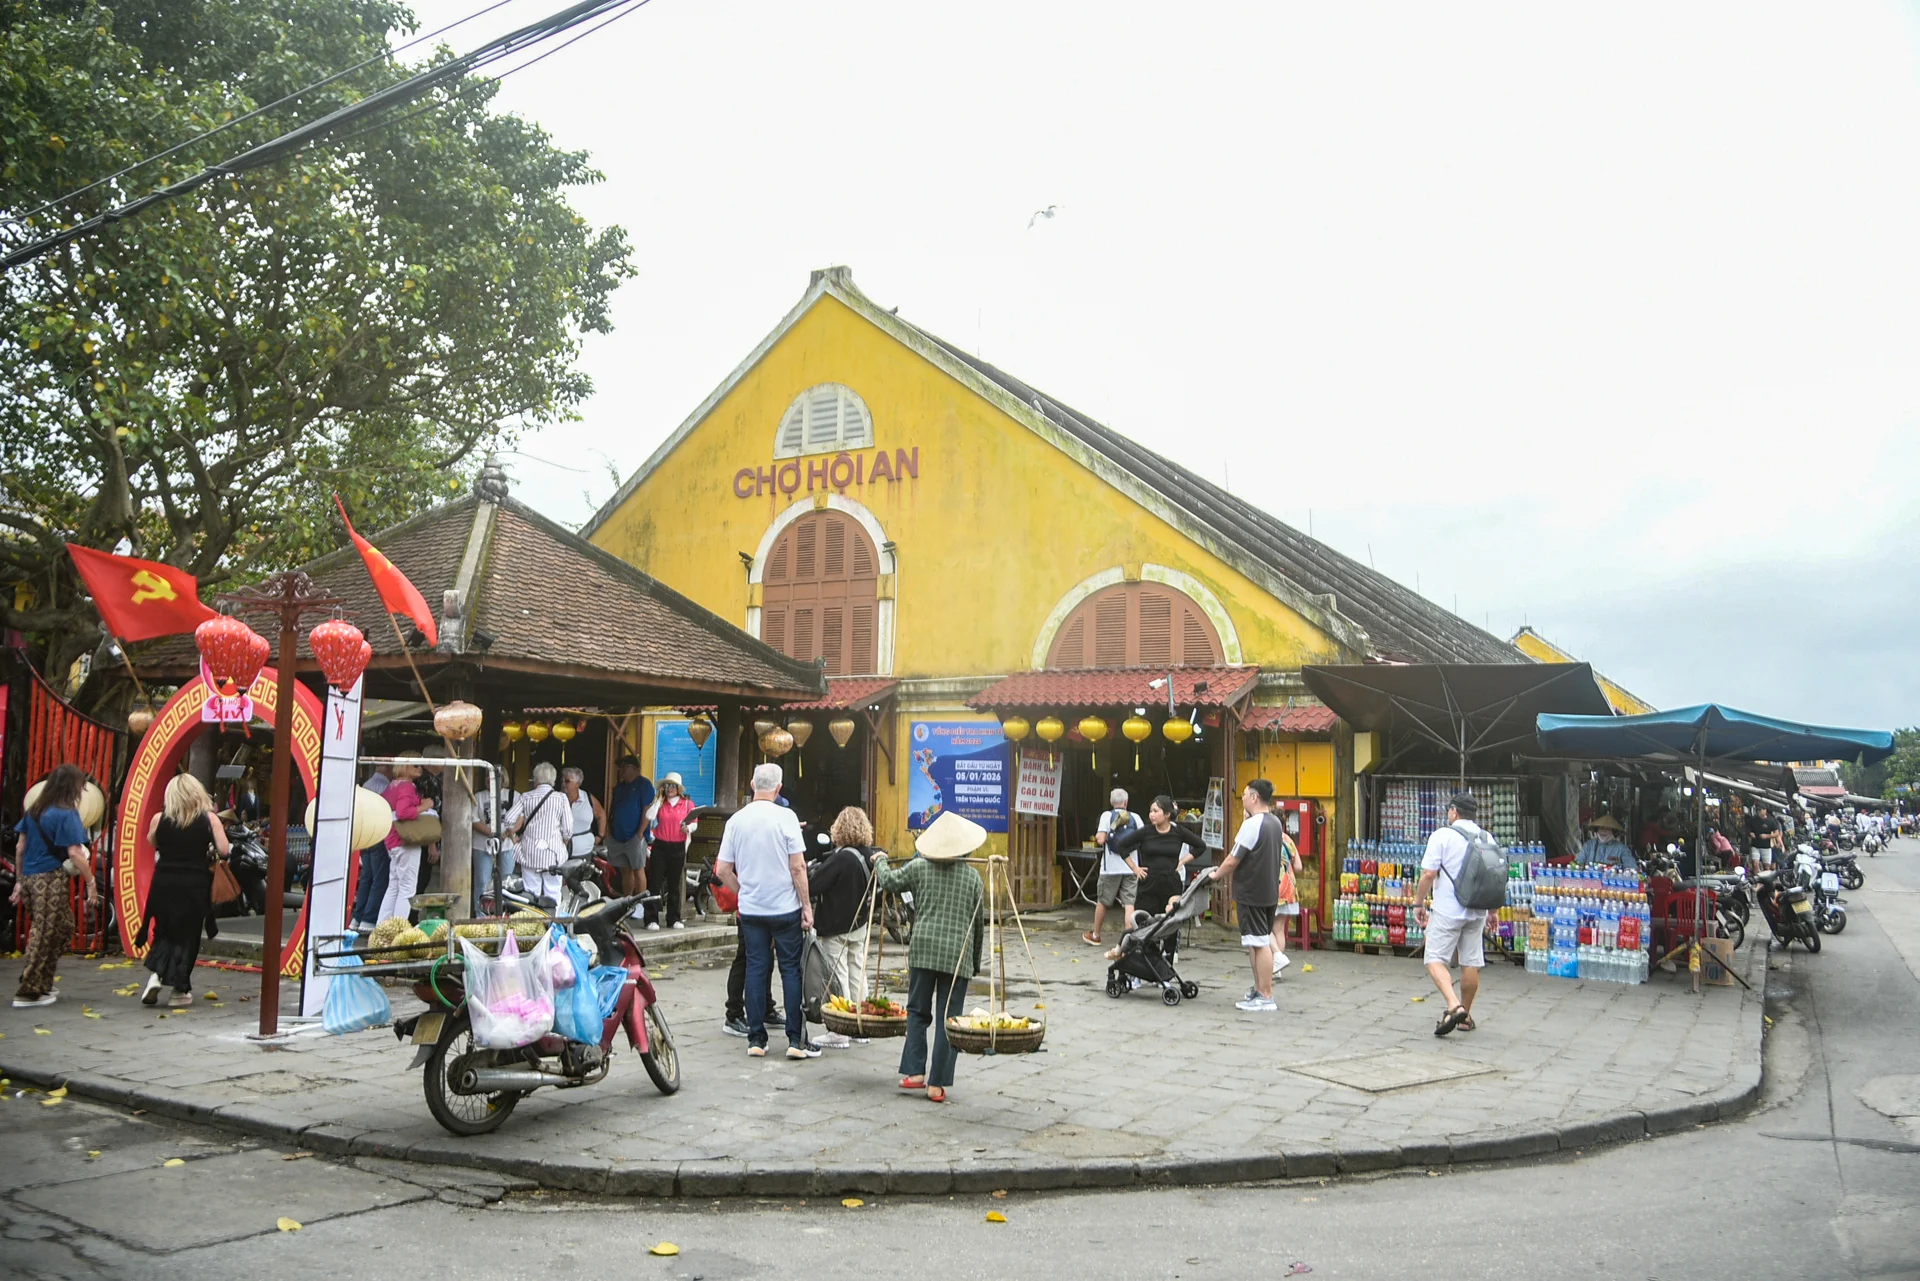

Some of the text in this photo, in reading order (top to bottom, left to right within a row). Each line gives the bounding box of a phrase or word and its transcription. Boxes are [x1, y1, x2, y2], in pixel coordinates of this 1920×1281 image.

[733, 446, 919, 500] CHỢ HỘI AN
[1023, 760, 1042, 771] BÁNH
[956, 771, 1001, 781] 05/01/2026
[1022, 771, 1056, 786] HẾN XÀO
[1021, 787, 1037, 796] CAO
[955, 795, 1001, 803] TRÊN TOÀN QUỐC
